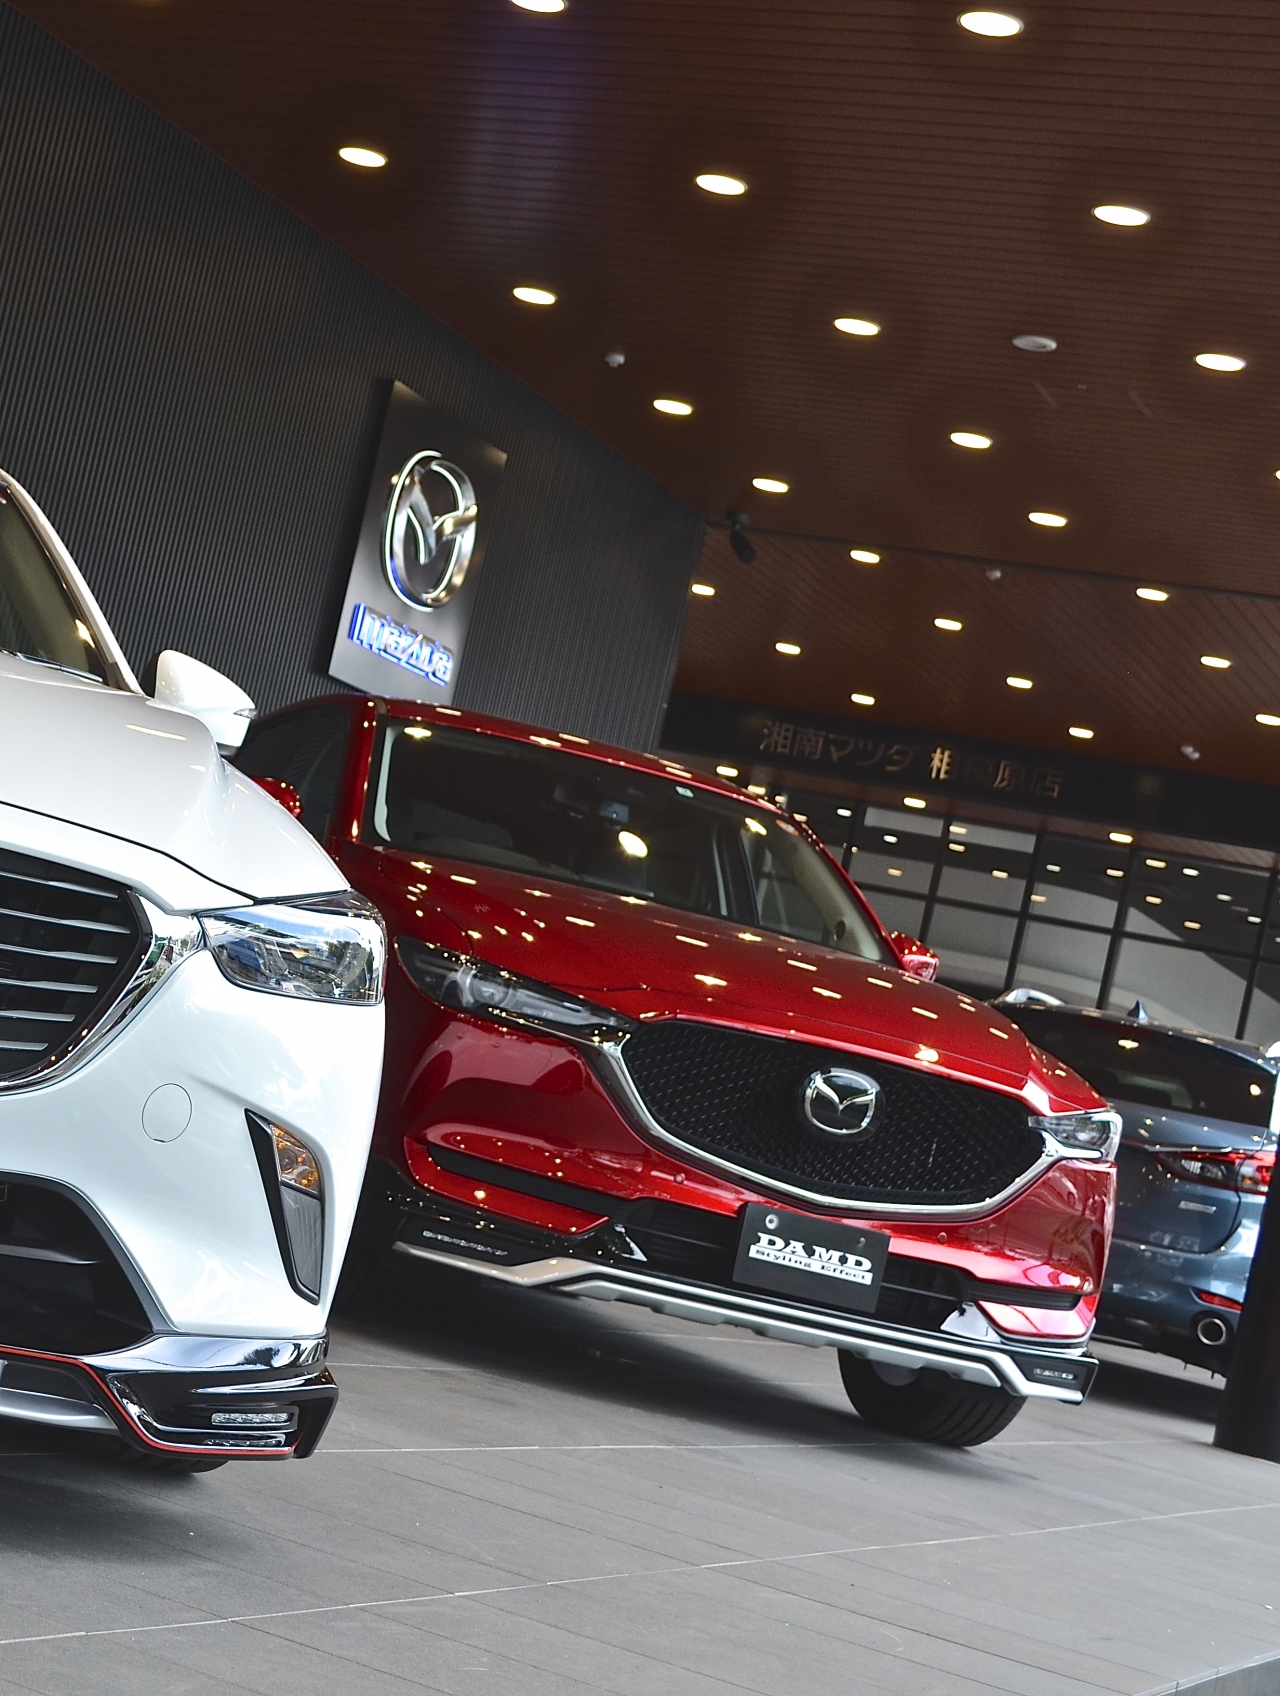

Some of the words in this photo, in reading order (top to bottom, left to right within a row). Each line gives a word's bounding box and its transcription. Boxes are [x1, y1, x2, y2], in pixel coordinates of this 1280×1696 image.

[758, 720, 920, 772] 湘南マツダ
[754, 1231, 873, 1273] DAMD
[754, 1248, 813, 1270] Styling
[820, 1263, 867, 1281] Effect
